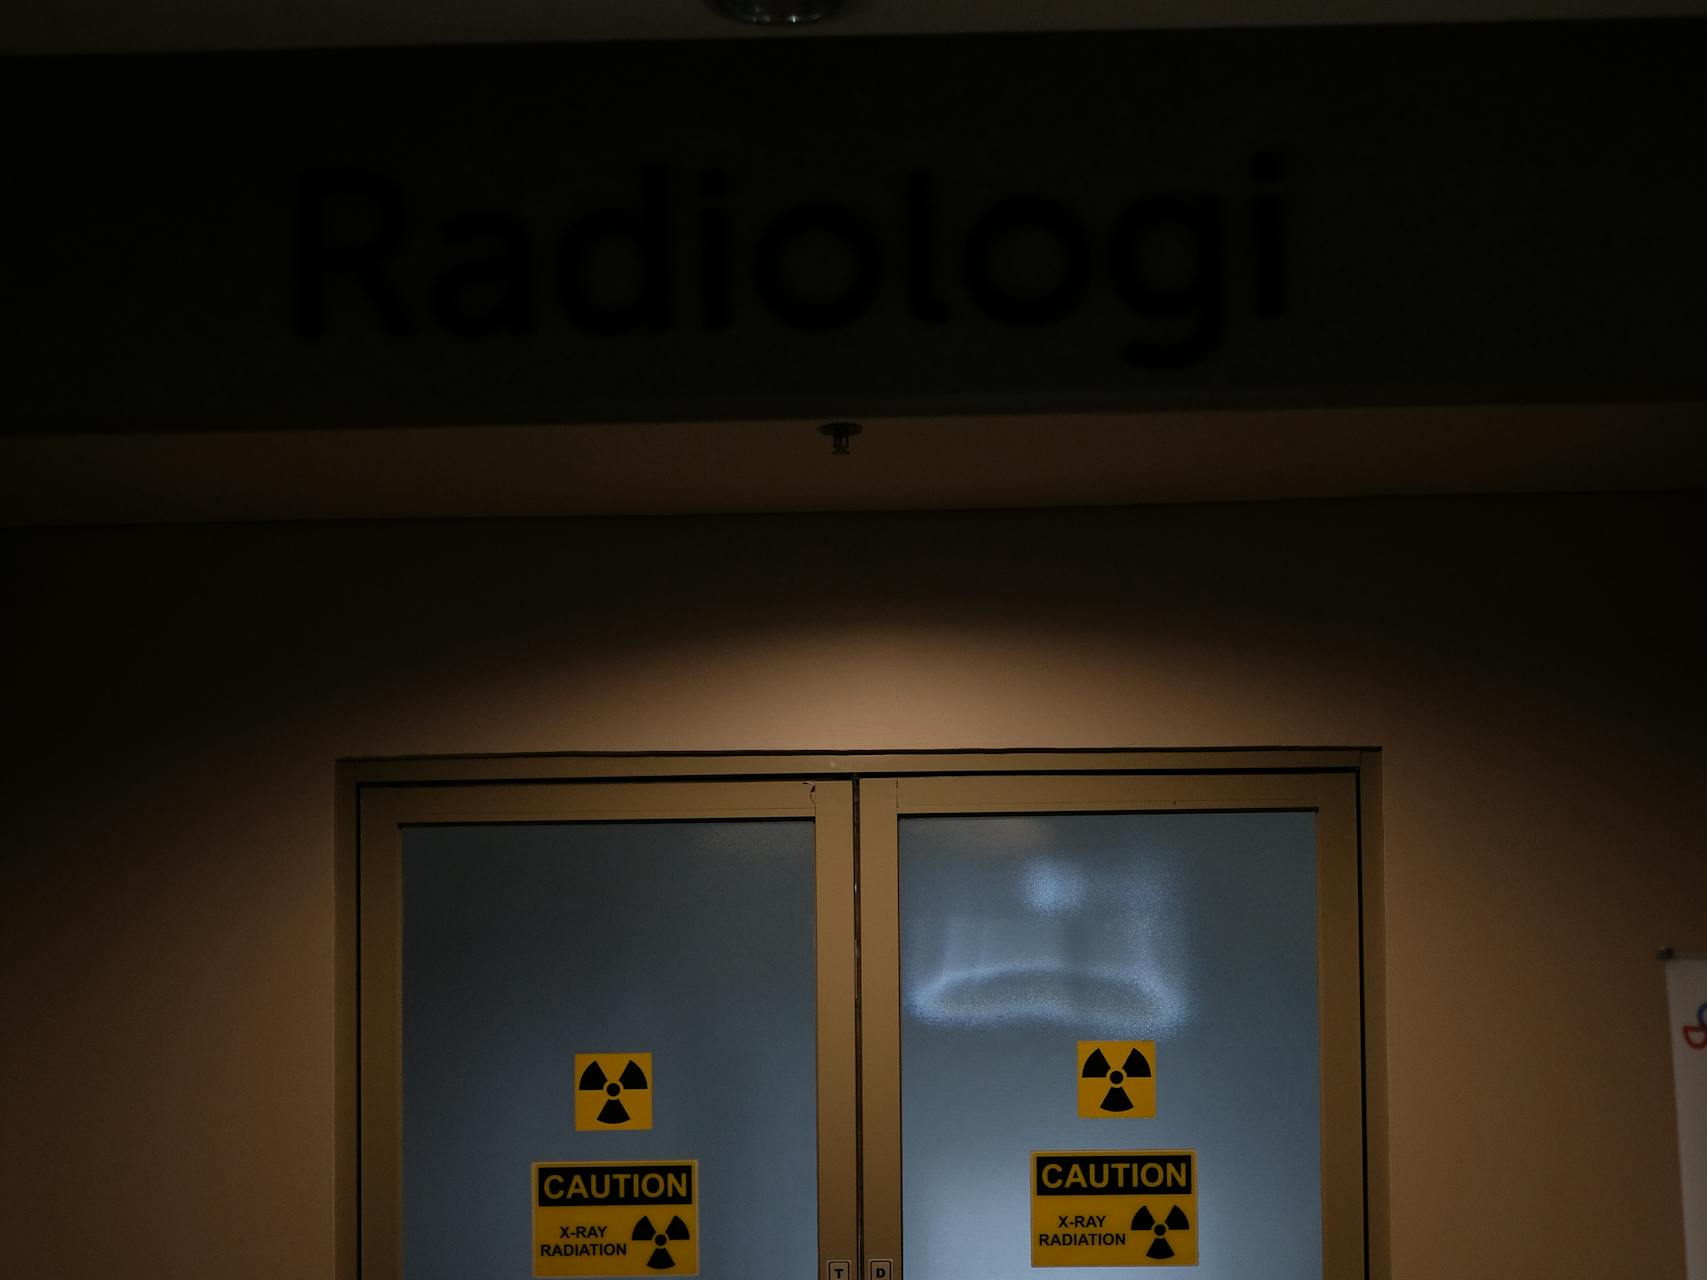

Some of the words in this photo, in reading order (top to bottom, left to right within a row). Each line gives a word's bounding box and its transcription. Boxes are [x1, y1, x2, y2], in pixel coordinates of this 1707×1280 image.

[295, 153, 1284, 368] Radiologi
[1041, 1162, 1187, 1189] CAUTION
[543, 1172, 687, 1200] CAUTION
[1058, 1215, 1107, 1228] X-RAY
[560, 1225, 608, 1239] X-RAY
[1039, 1233, 1126, 1246] RADIATION
[540, 1243, 627, 1257] RADIATION
